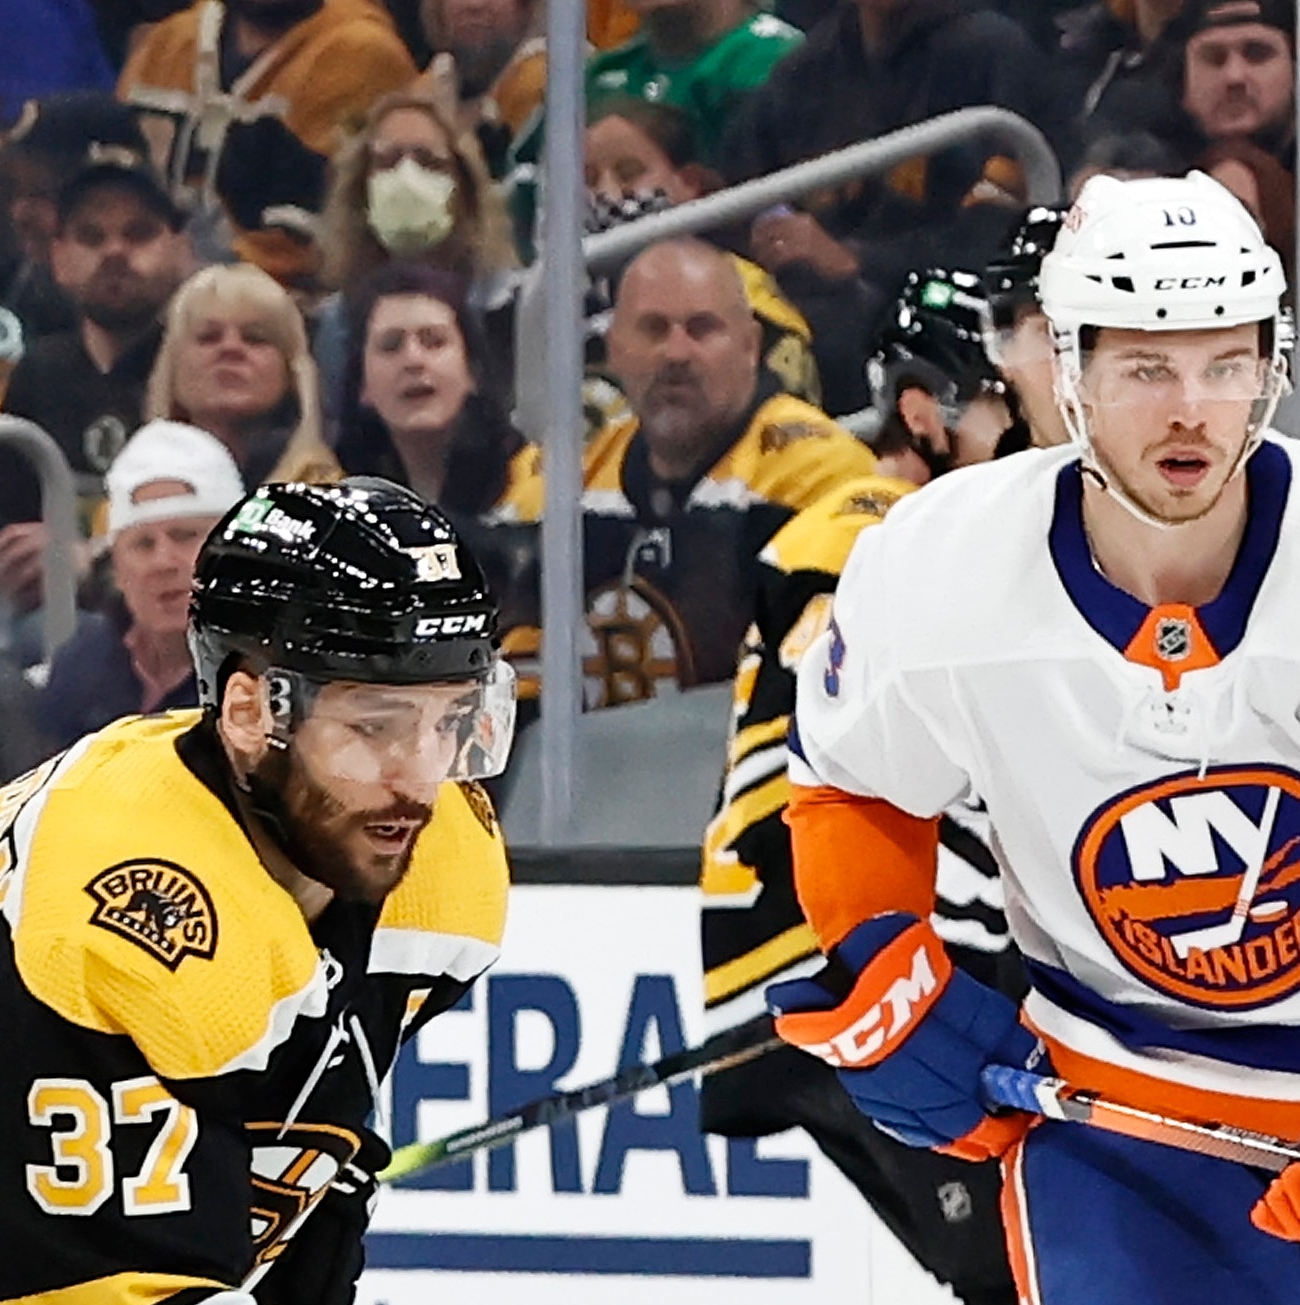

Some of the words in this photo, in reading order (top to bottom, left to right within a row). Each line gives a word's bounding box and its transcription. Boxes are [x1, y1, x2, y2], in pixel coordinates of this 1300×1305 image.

[1153, 276, 1227, 291] CCM
[264, 507, 317, 541] Bank
[415, 614, 487, 637] CCM
[1120, 786, 1282, 905] NY
[101, 868, 208, 945] BRUINS
[26, 1076, 198, 1217] 37
